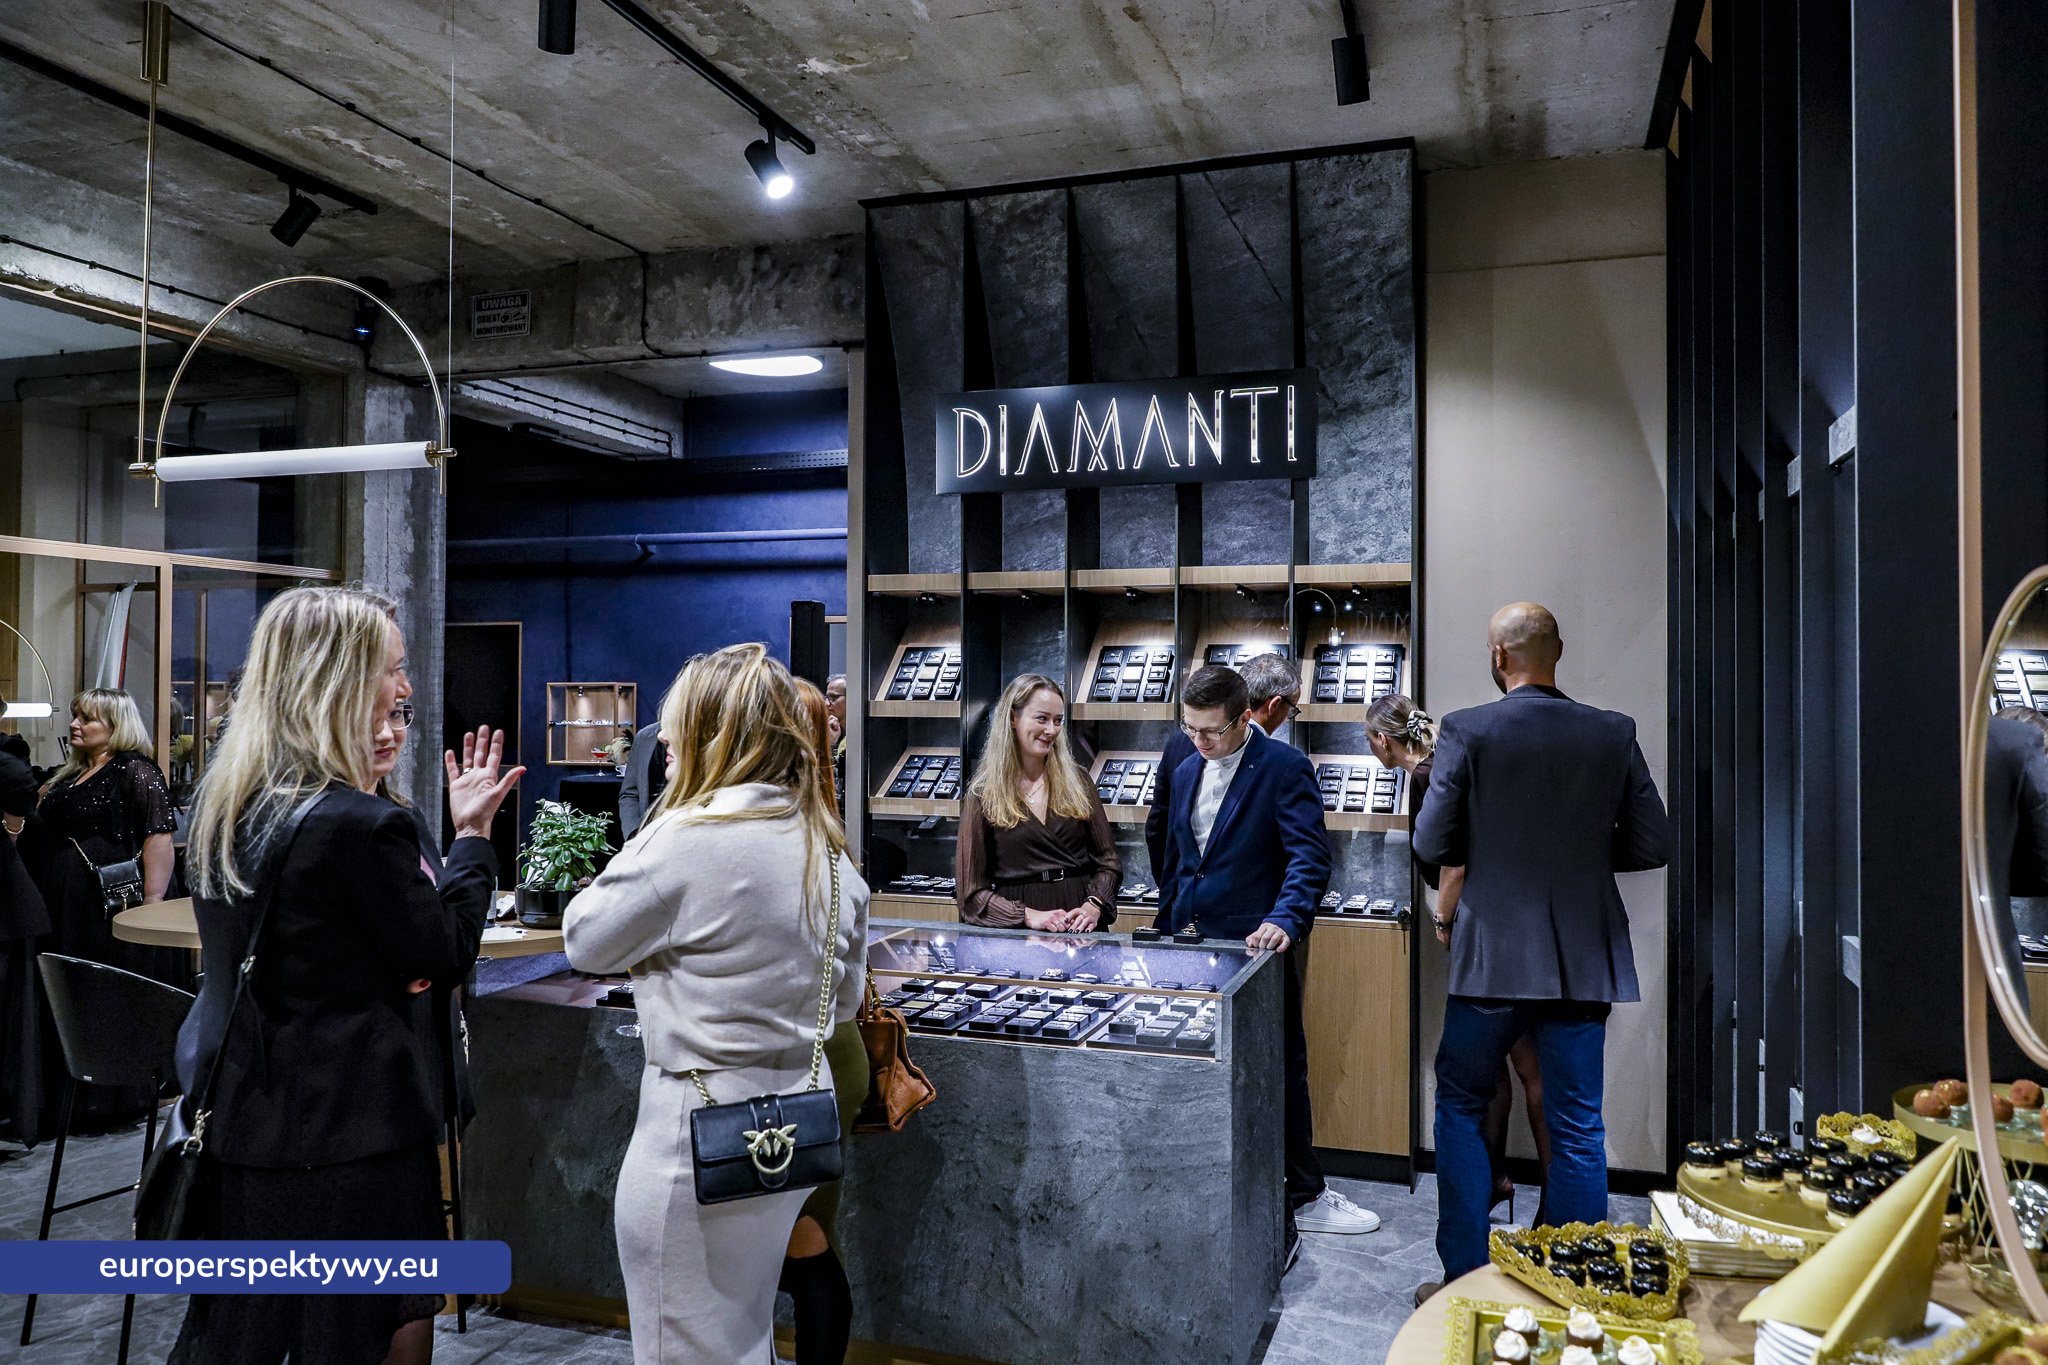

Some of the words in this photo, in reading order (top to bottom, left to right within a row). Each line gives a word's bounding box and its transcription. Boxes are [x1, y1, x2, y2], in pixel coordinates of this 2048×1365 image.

[481, 296, 522, 310] UWAGA
[477, 314, 500, 324] OBIEKT
[477, 323, 526, 335] MONITOROWANY
[952, 385, 1298, 478] DIAMANTI
